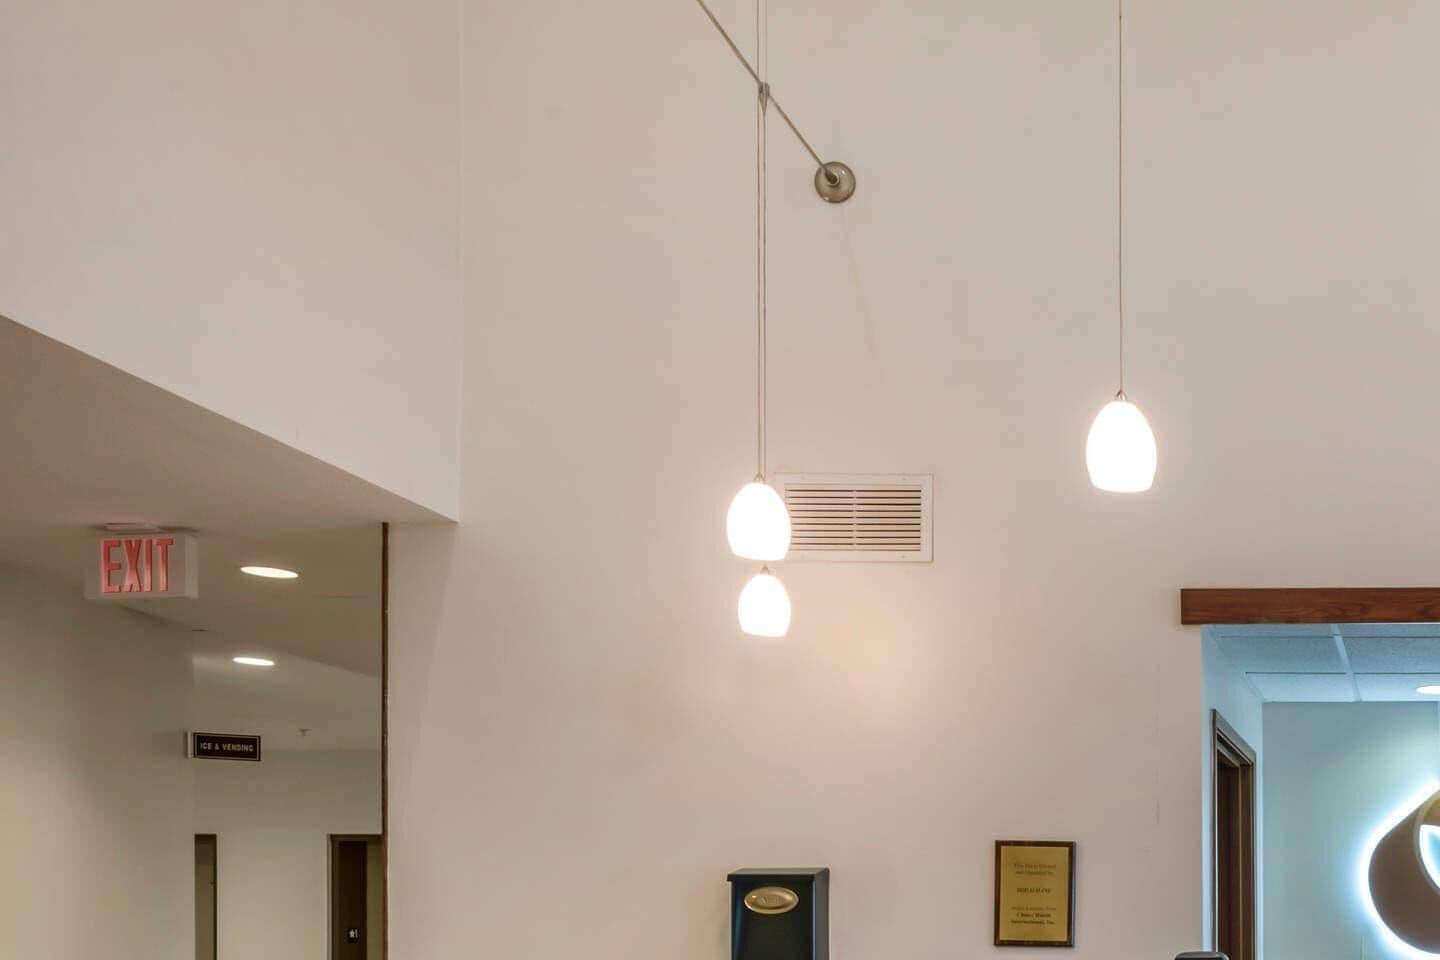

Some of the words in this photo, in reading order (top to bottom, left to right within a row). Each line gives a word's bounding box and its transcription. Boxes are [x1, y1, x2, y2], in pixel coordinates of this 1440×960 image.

[101, 538, 174, 593] EXIT
[200, 742, 212, 751] ICE
[222, 743, 254, 752] VENDING
